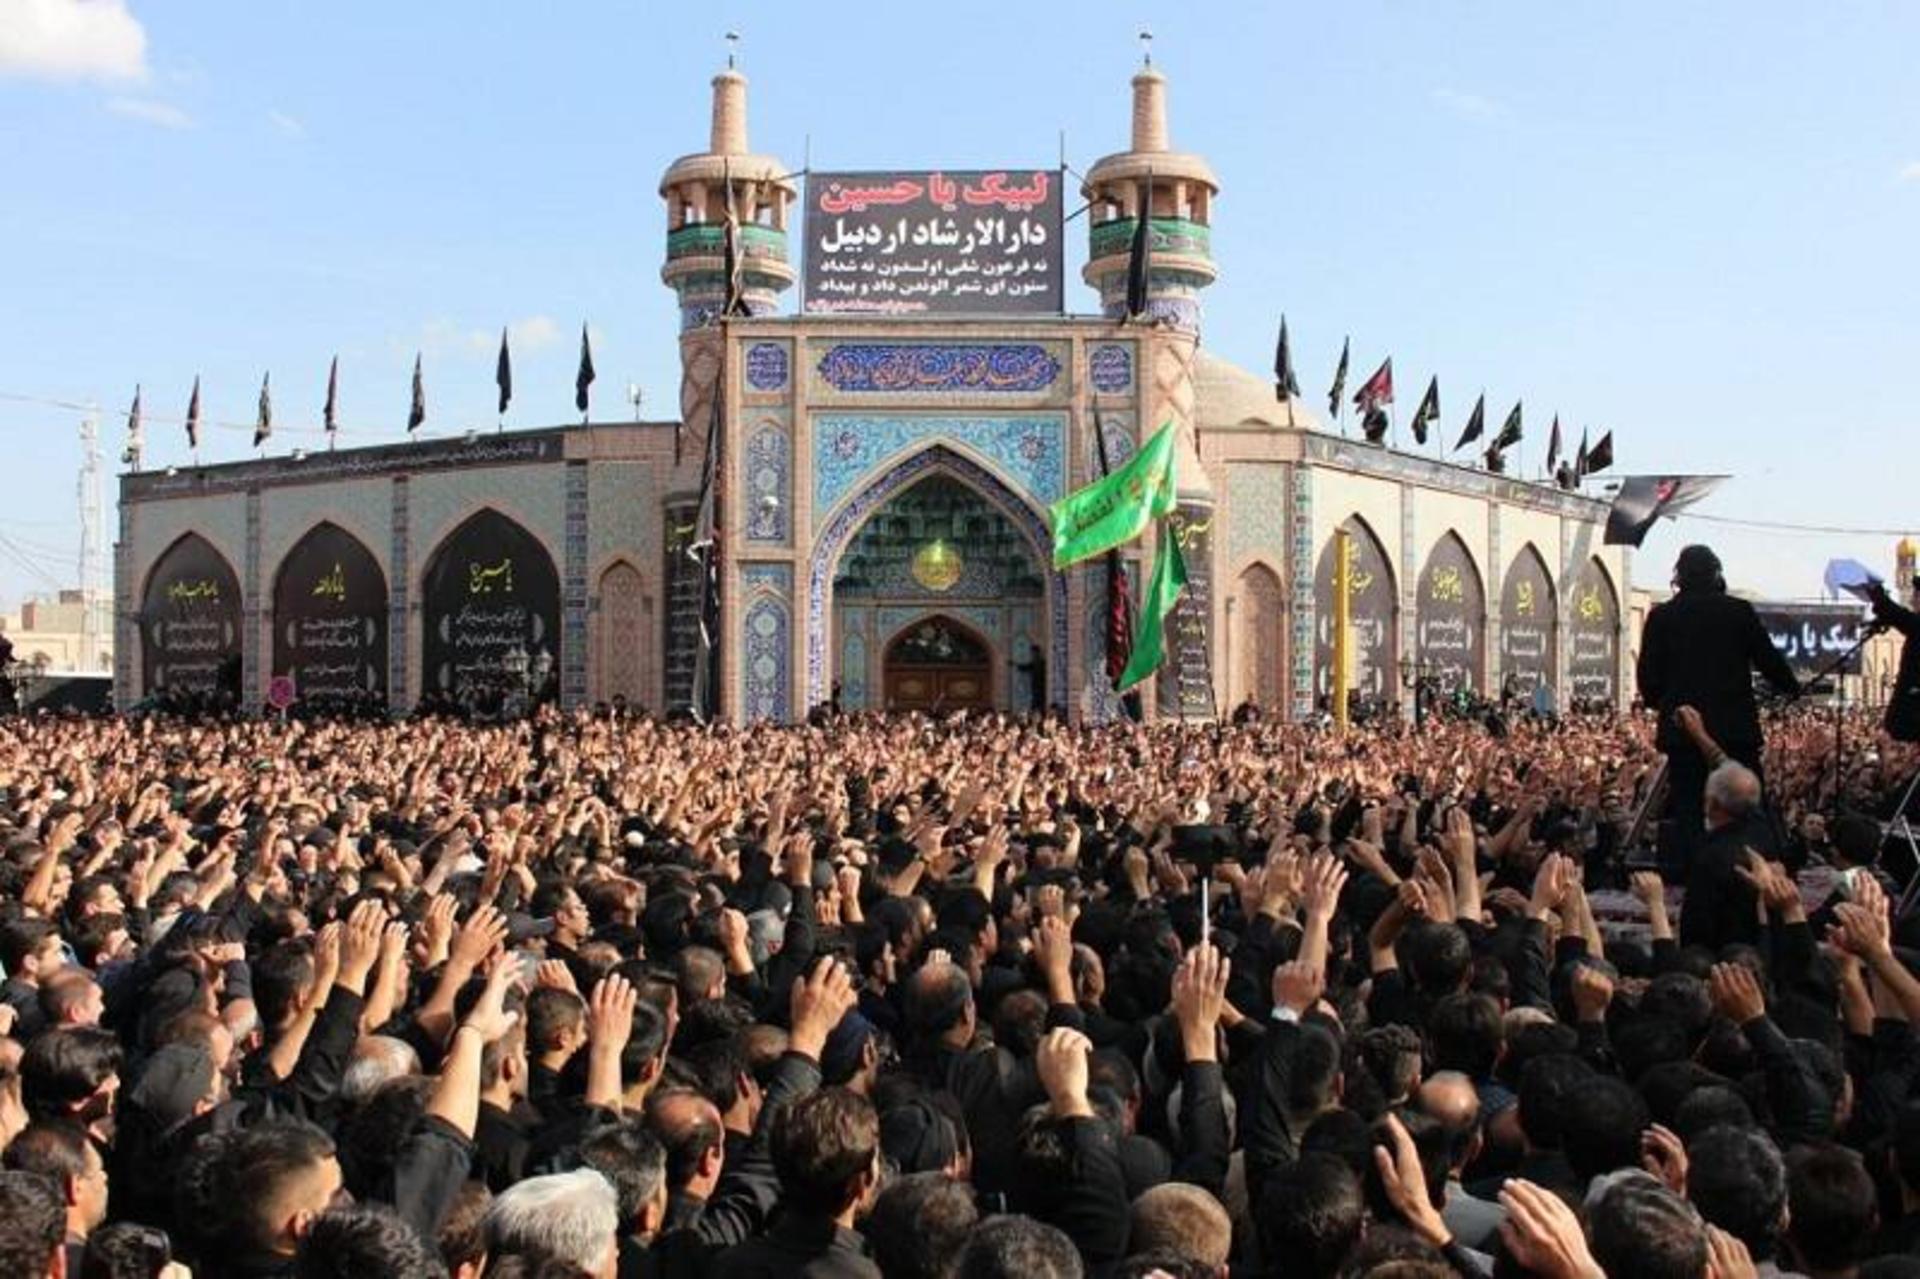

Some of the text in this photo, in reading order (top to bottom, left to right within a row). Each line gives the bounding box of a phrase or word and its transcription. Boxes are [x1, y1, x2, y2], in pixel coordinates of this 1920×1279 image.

[820, 172, 1048, 214] لبیک یا حسین
[820, 218, 906, 253] اردبیل
[981, 259, 1030, 276] فرعون
[1802, 622, 1817, 657] یا
